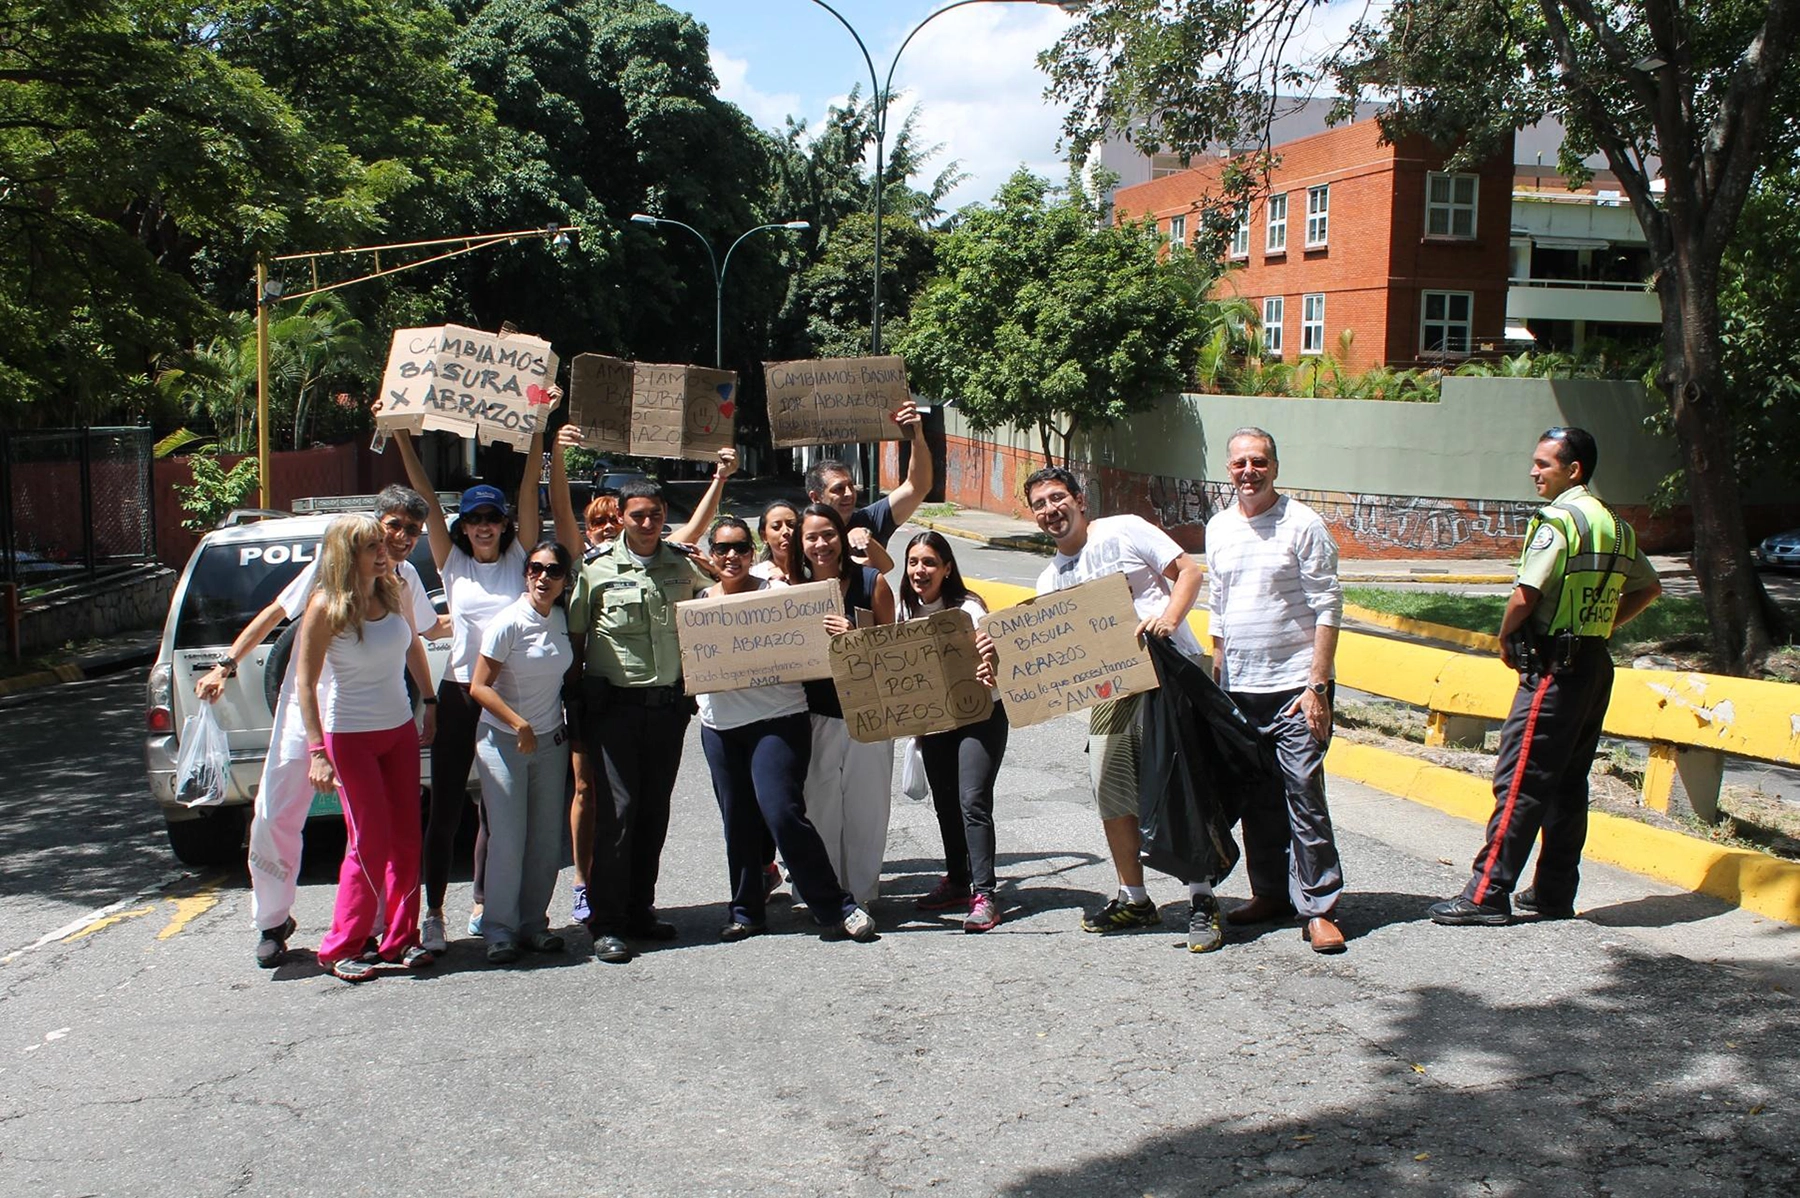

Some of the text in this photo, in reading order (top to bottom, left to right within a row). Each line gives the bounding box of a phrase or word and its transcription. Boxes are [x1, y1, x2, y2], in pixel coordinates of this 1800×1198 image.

[409, 337, 548, 376] CAMBIAMOS
[400, 360, 523, 397] BASURA
[597, 382, 686, 407] BASURA
[389, 385, 538, 434] X ABRAZOS
[780, 391, 888, 412] POR ABRAZOS
[587, 418, 693, 445] ABRAZOS
[816, 426, 858, 442] AMOR
[831, 618, 957, 655] CAMBIAMOS
[987, 598, 1078, 640] CAMBIAMOS
[1013, 615, 1119, 651] BASURA POR
[693, 629, 805, 663] POR ABRAZOS
[842, 643, 962, 682] BASURA
[1012, 644, 1087, 681] ABRAZOS
[885, 673, 934, 695] POR
[1005, 687, 1037, 703] Todo
[856, 702, 945, 737] ABAZOS
